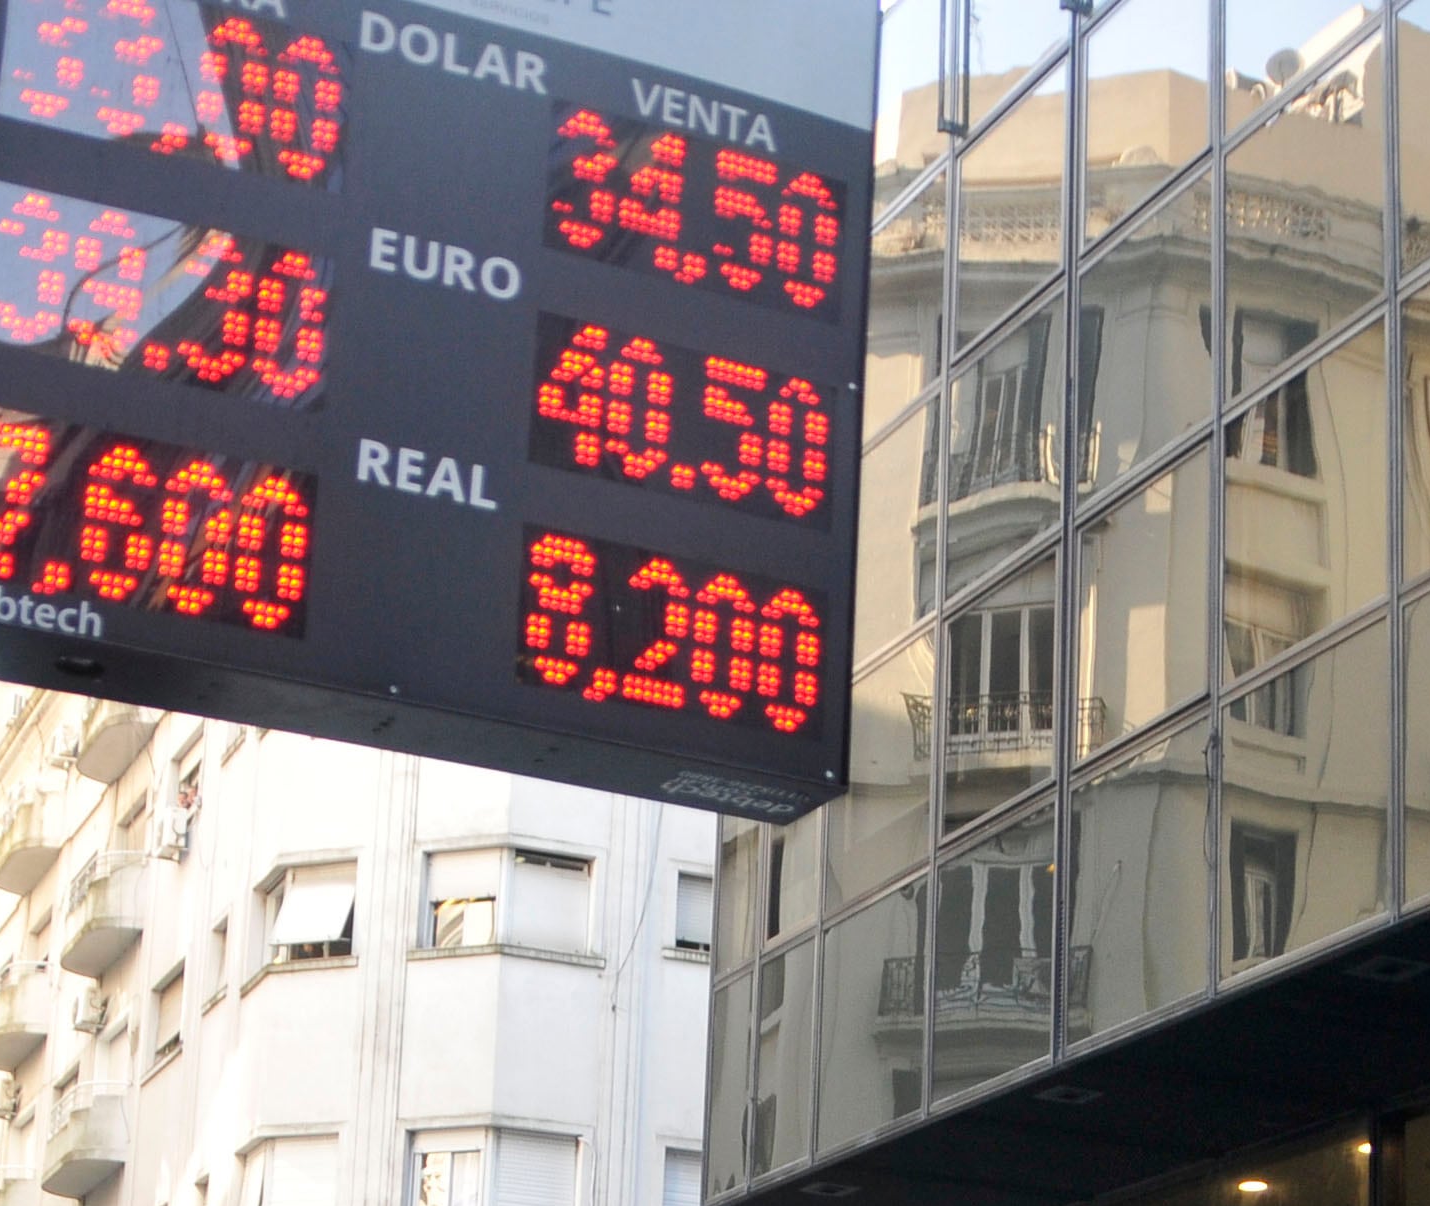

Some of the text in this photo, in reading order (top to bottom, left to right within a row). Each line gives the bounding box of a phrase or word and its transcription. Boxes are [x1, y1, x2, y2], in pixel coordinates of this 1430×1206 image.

[359, 11, 548, 95] DOLAR
[631, 78, 777, 153] VENTA
[370, 227, 521, 302] EURO
[357, 438, 497, 510] REAL
